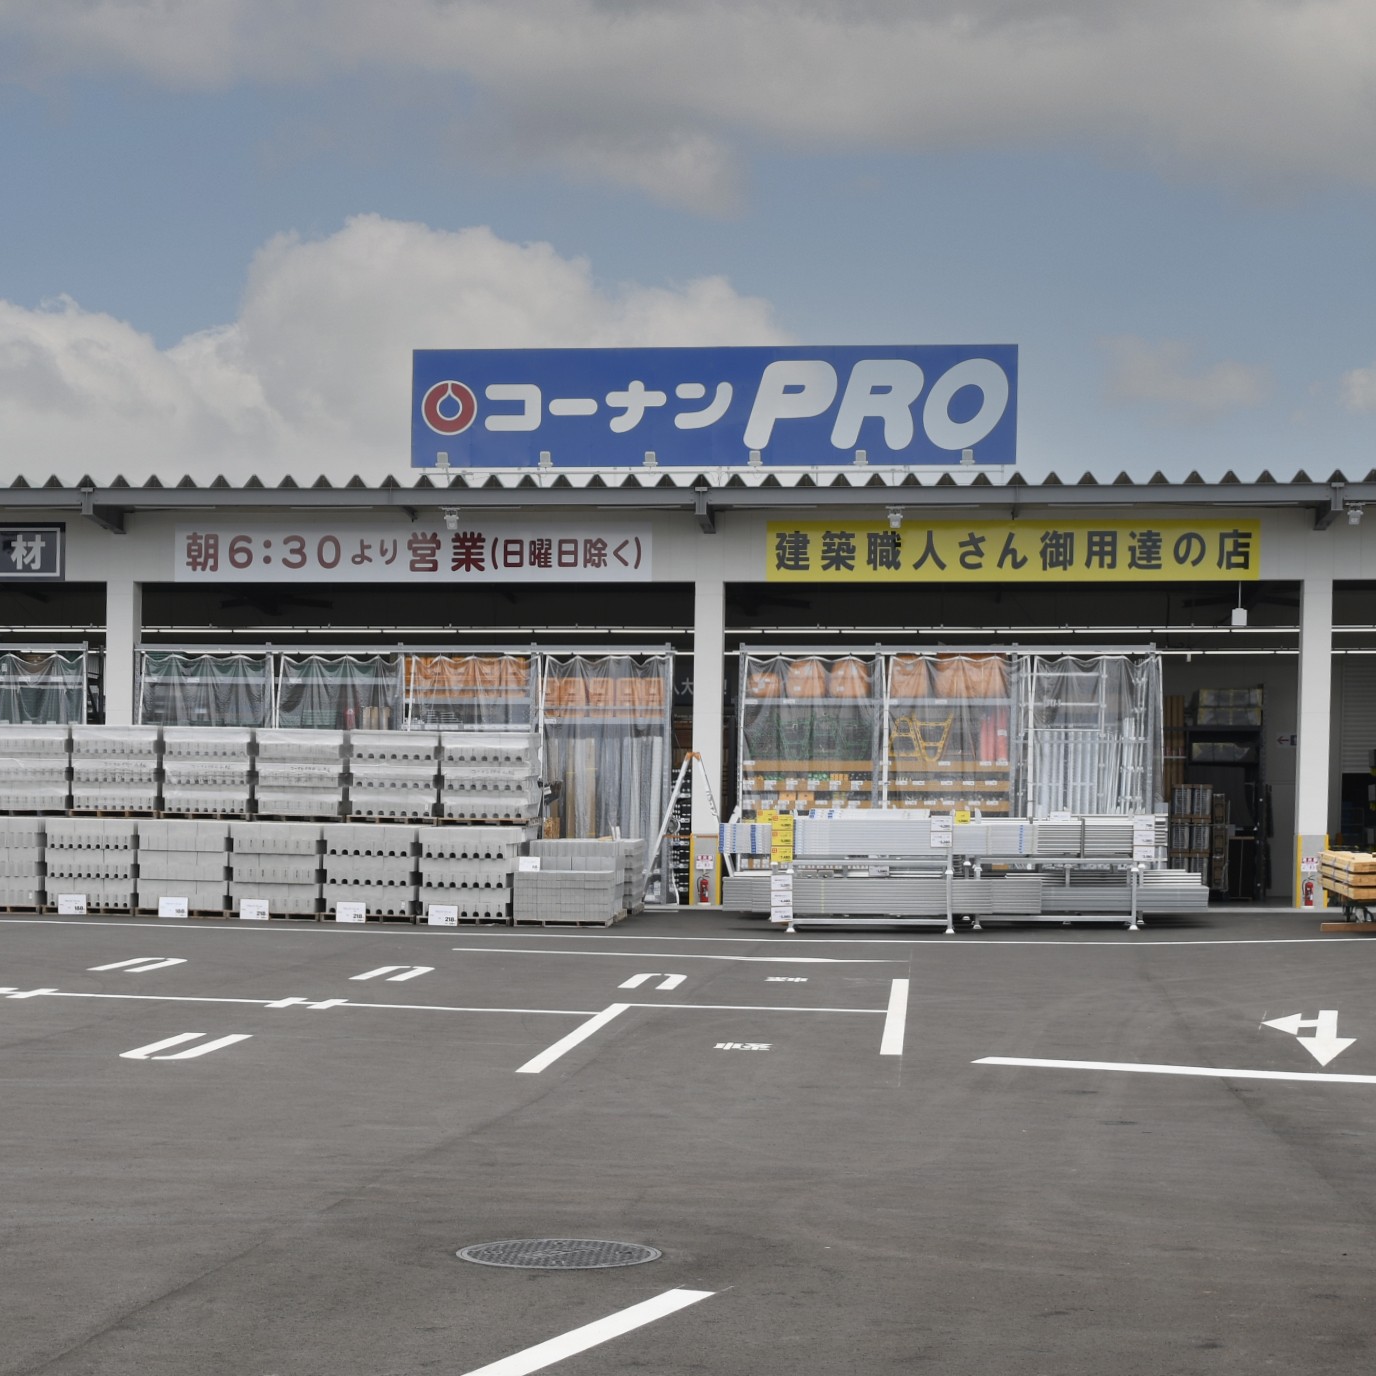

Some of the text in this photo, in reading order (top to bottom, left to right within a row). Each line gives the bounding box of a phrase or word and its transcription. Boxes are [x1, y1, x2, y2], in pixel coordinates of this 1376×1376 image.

[484, 357, 1009, 451] コーナン PRO
[774, 529, 1254, 573] 建築職人さん御用達の店
